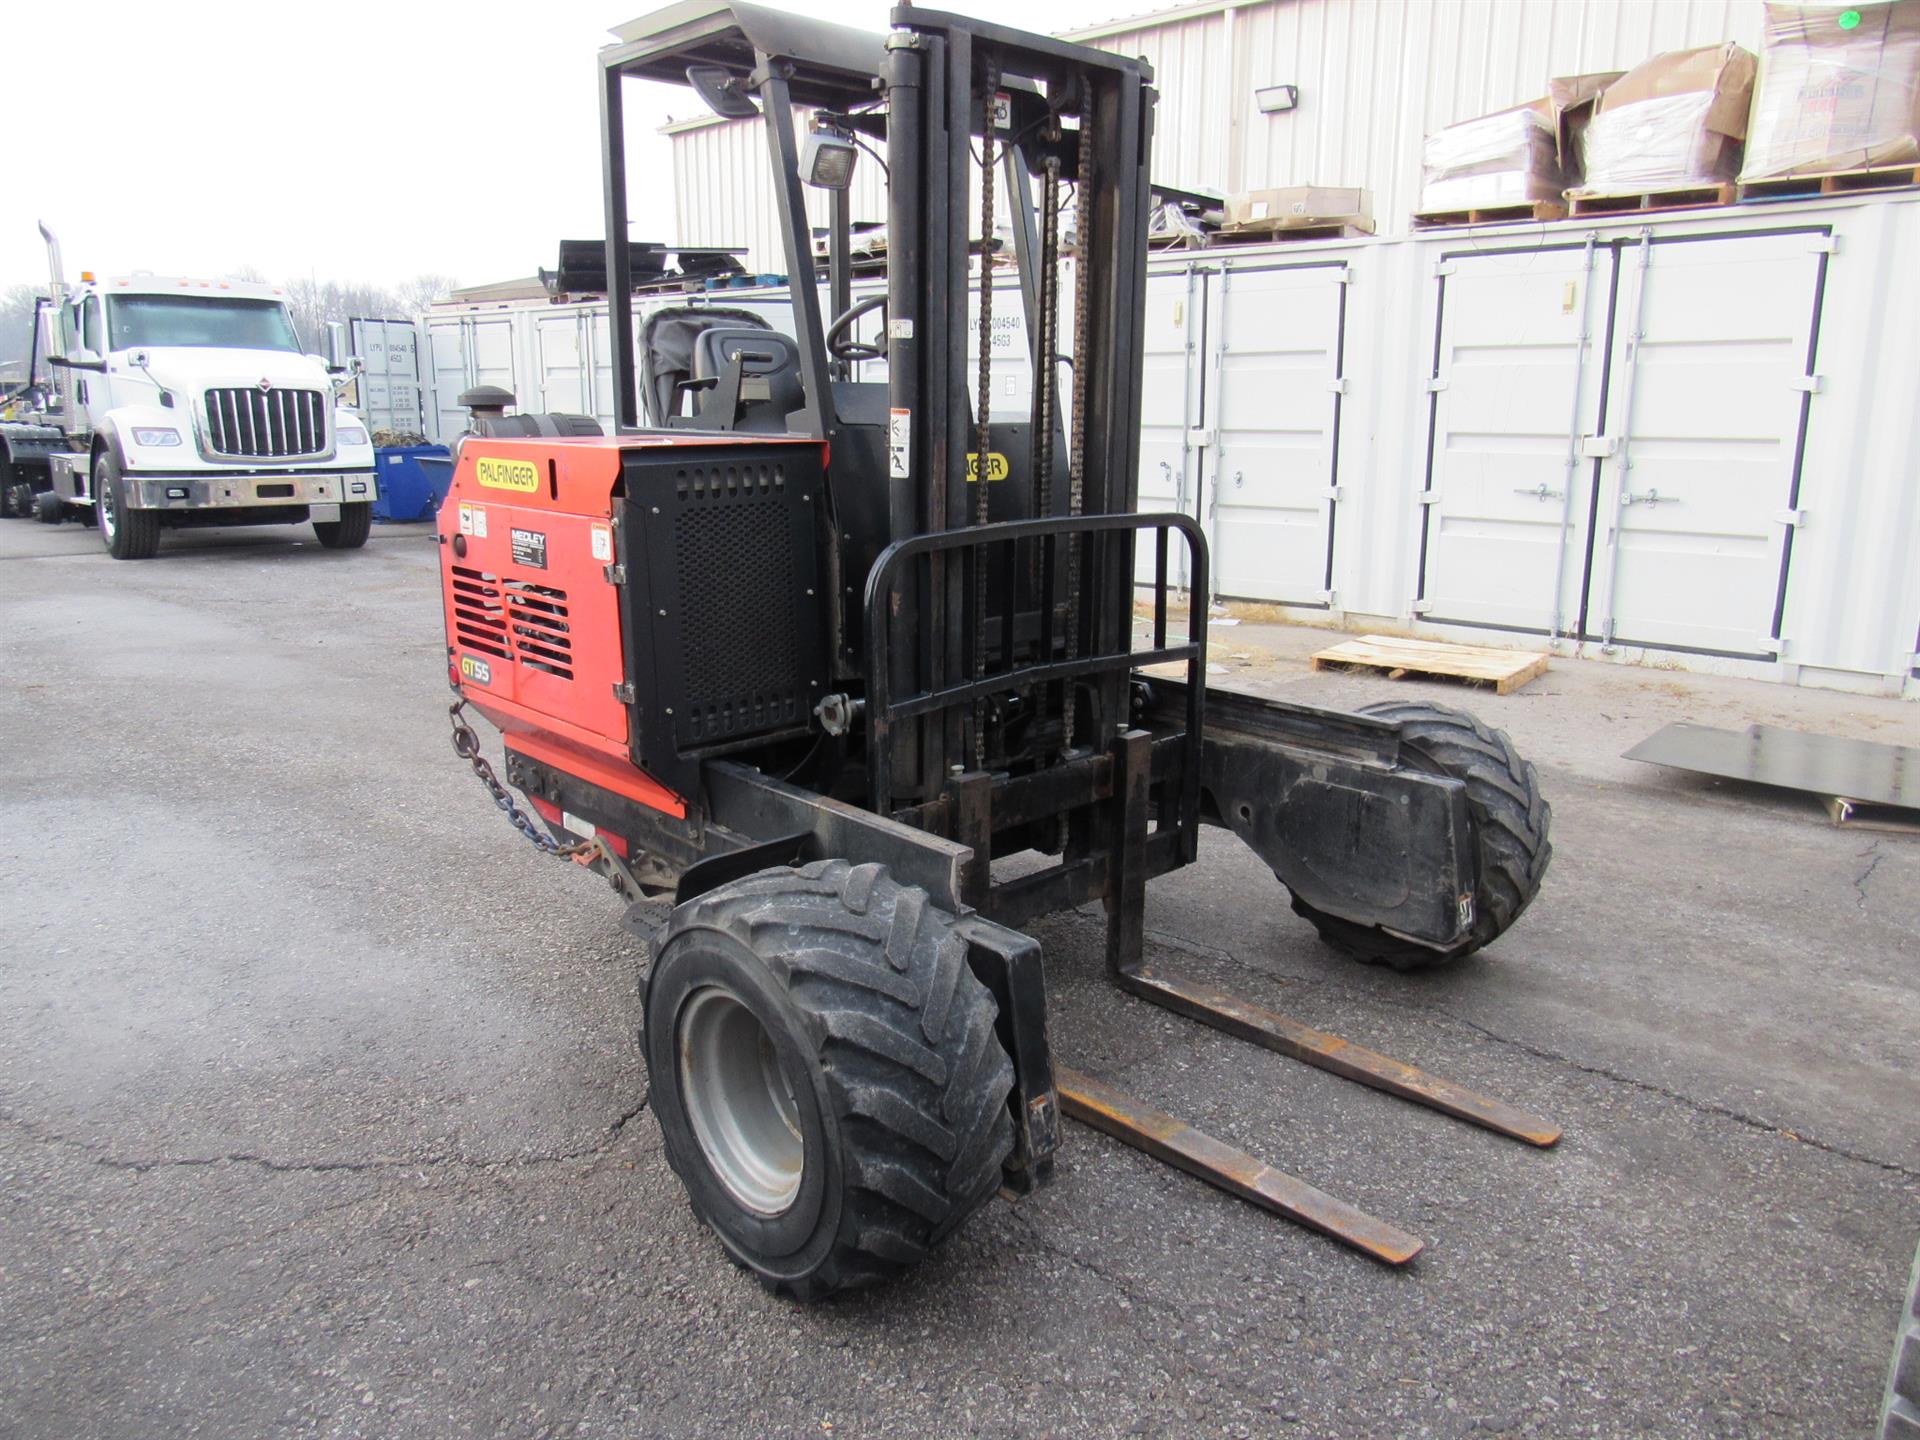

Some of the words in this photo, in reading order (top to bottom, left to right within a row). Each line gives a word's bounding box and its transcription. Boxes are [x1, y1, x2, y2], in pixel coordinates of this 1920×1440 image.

[992, 317, 1020, 329] 004540
[992, 335, 1010, 346] 45G3
[480, 462, 534, 487] PALFINGER
[511, 529, 545, 545] MEDLEY
[462, 656, 489, 682] GT55
